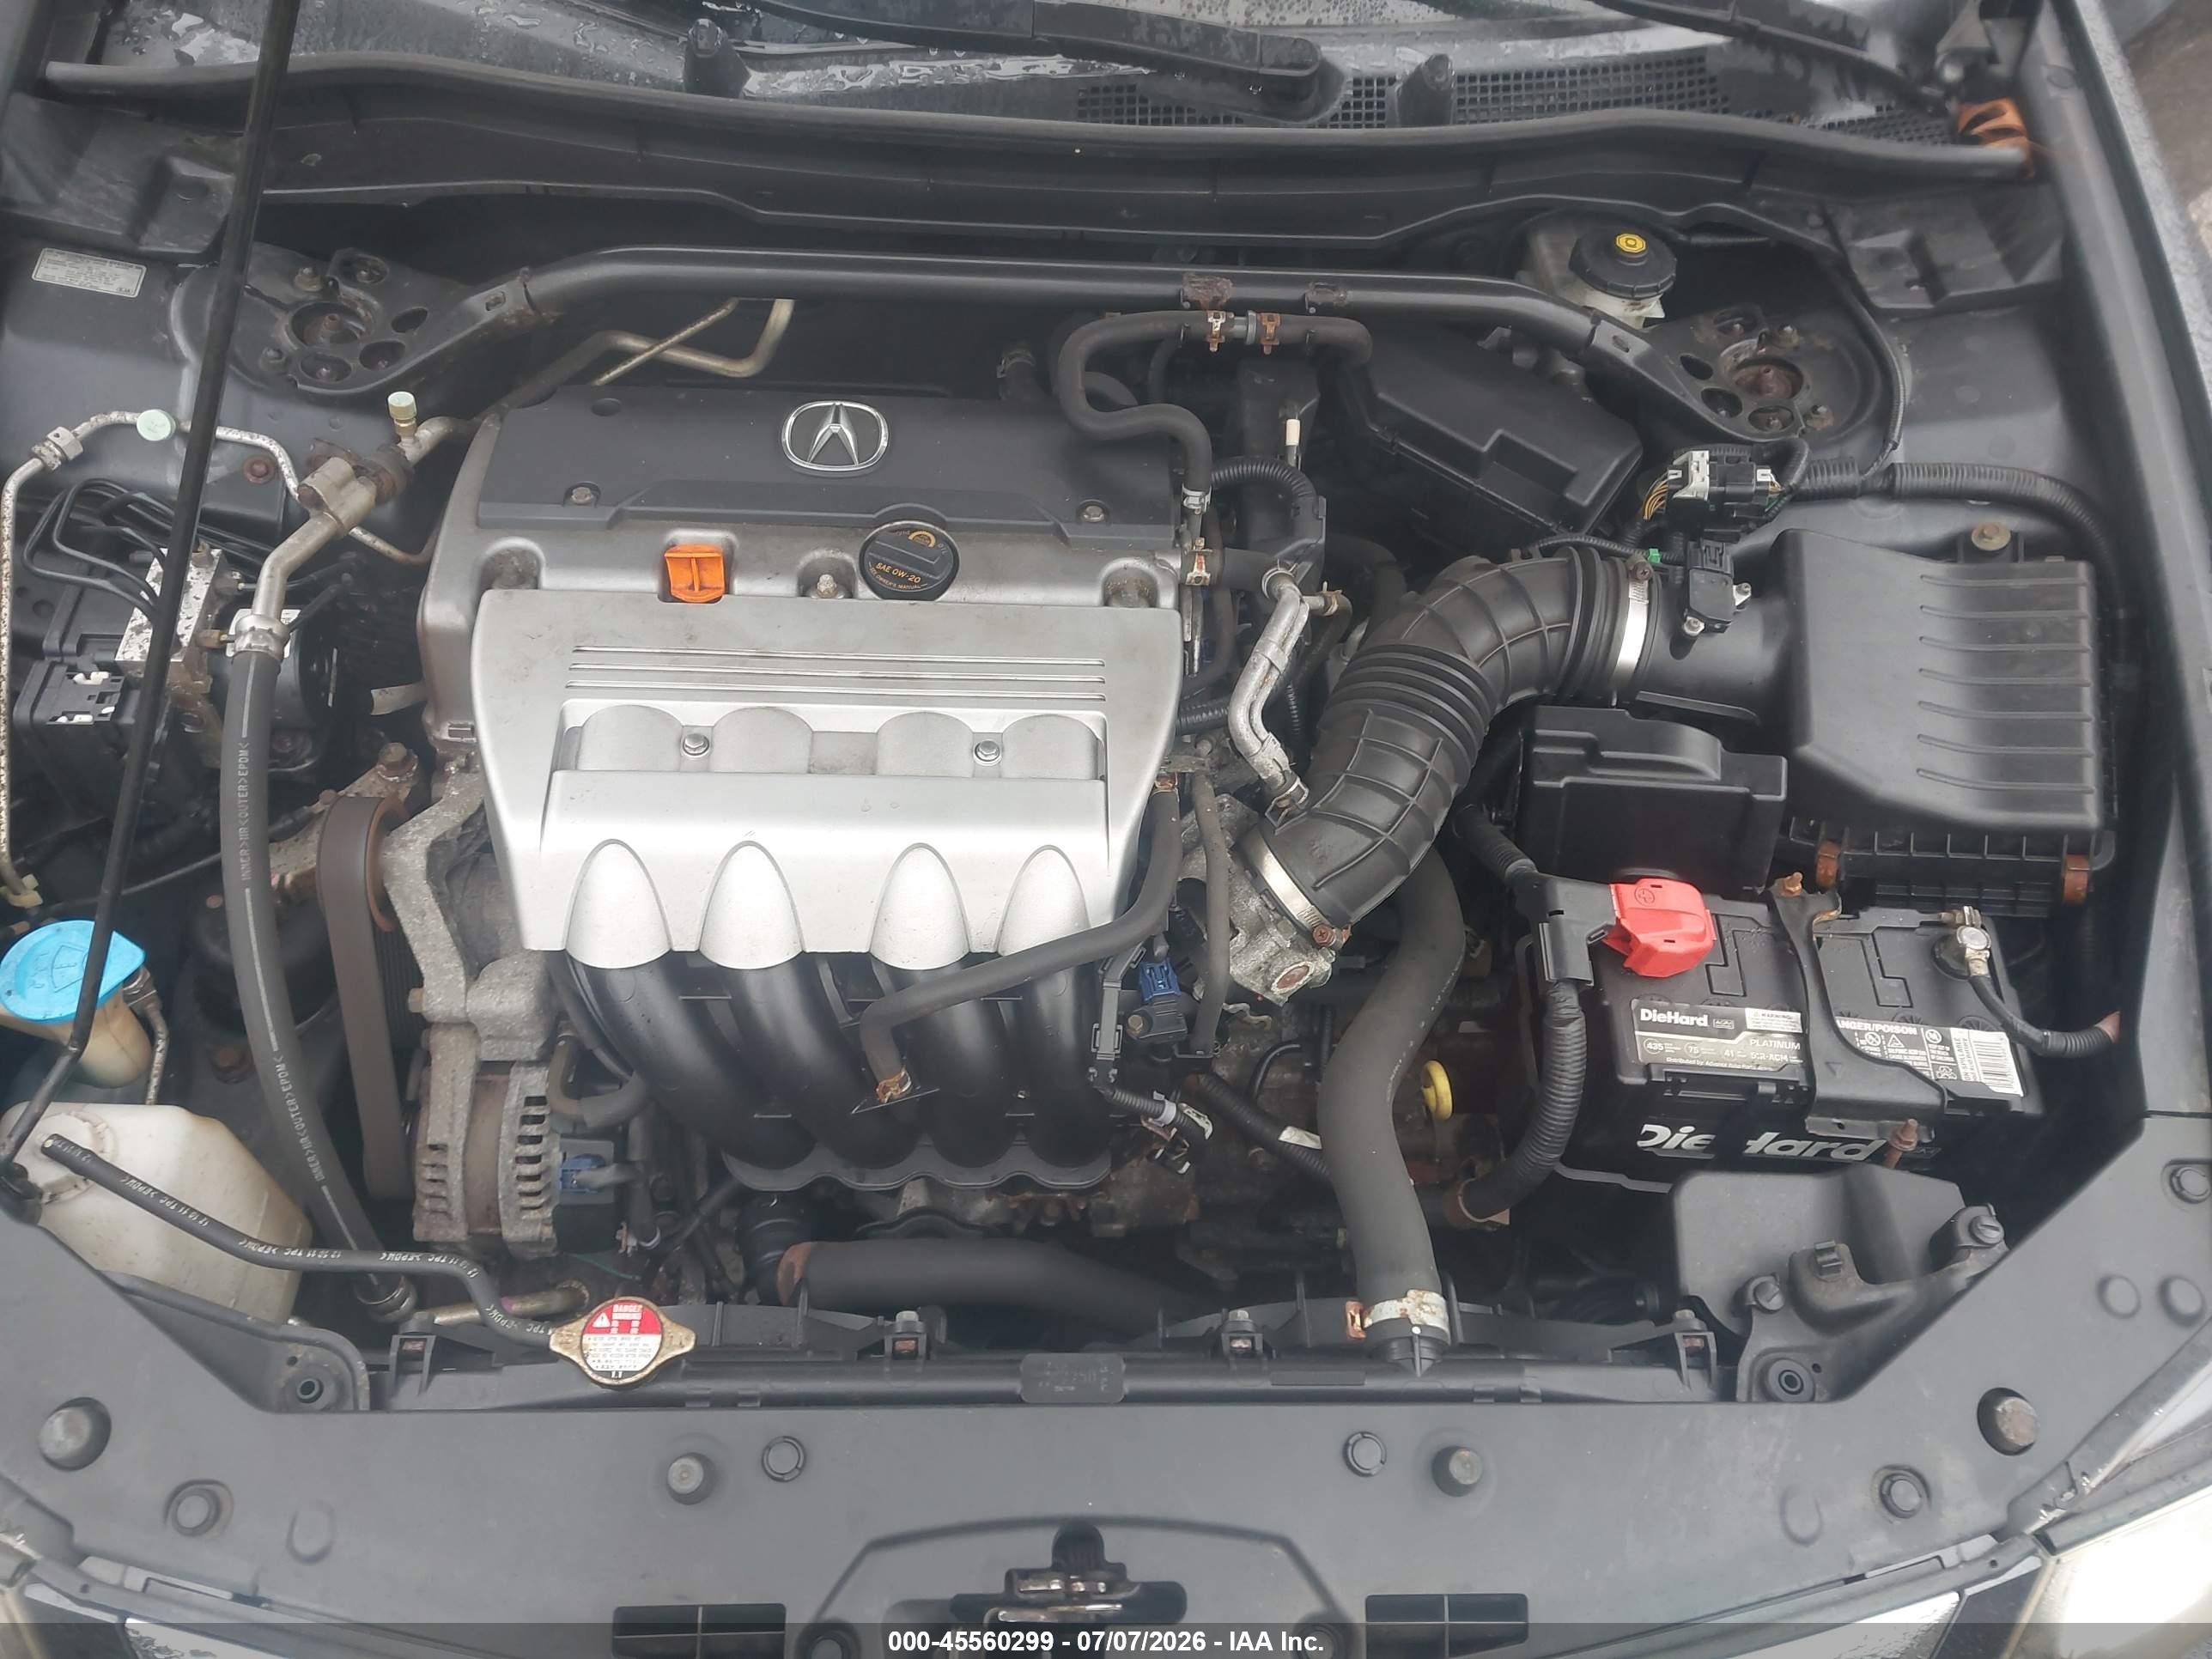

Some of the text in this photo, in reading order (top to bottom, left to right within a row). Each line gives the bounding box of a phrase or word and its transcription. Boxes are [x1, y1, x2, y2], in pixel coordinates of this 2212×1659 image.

[876, 562, 921, 584] SAE 0W-20
[1639, 1008, 1710, 1028] DieHard
[1836, 1019, 1918, 1036] ANGER/POISON
[1647, 1042, 1664, 1051] 435
[1749, 1038, 1801, 1050] PLATINUM
